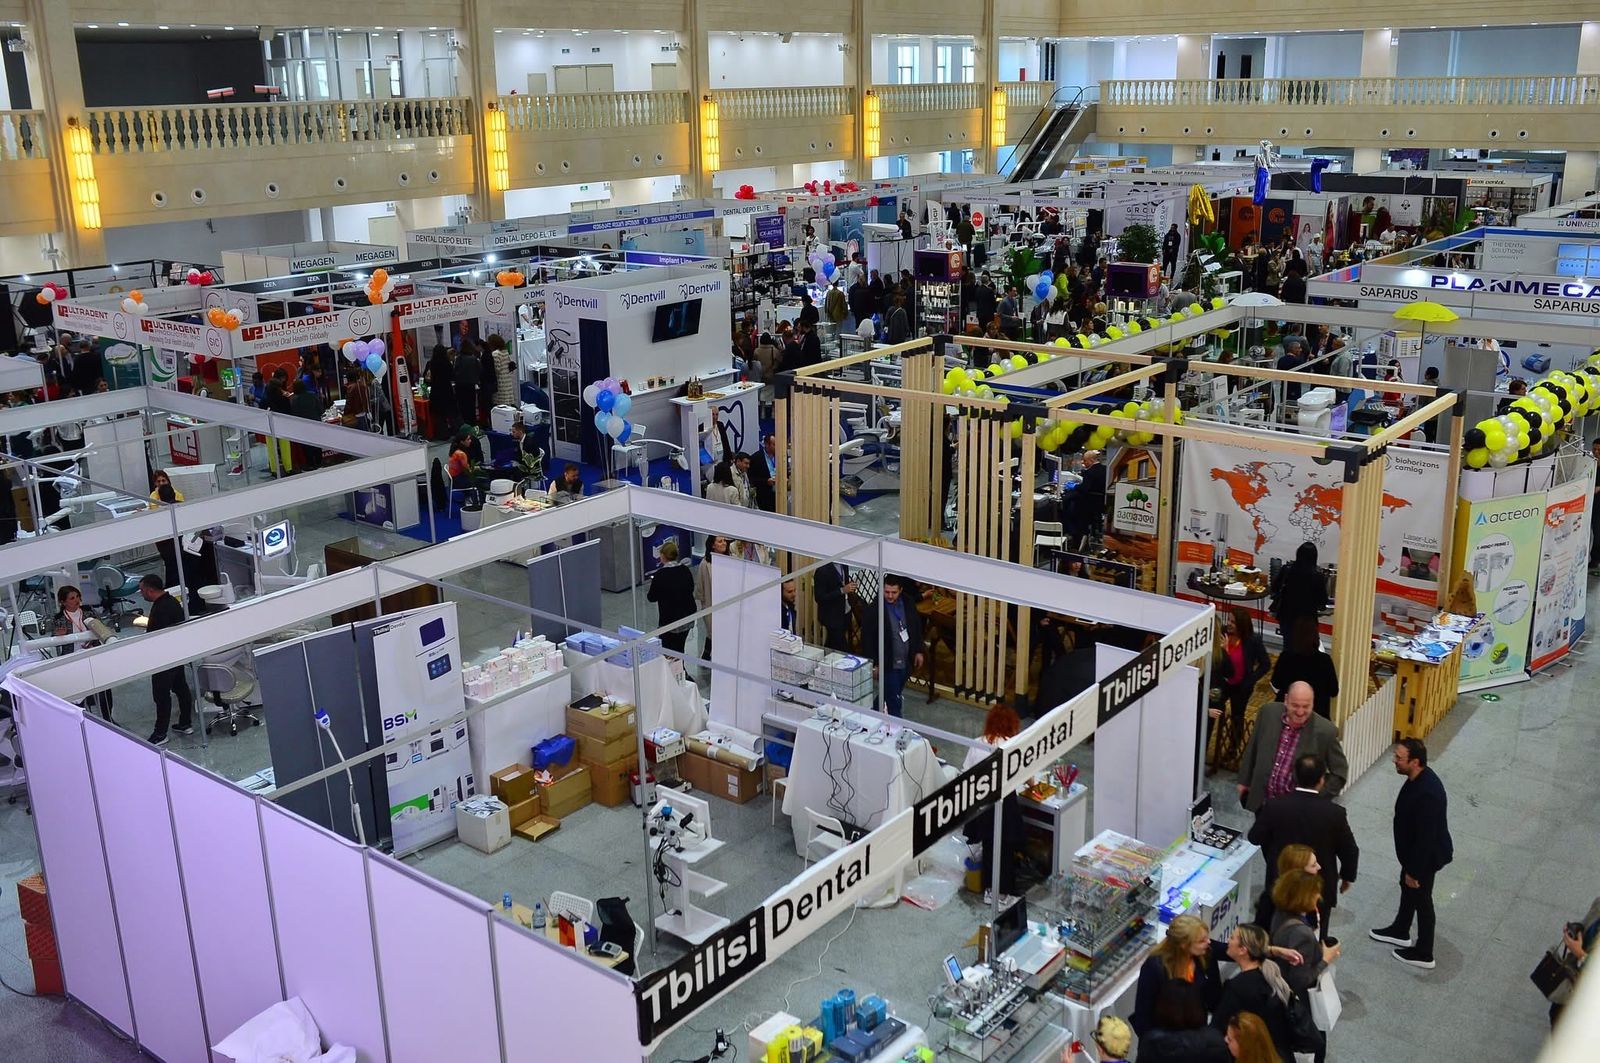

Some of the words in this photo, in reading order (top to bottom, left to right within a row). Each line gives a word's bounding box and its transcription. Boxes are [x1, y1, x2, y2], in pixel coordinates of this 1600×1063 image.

[723, 208, 742, 216] DENTAL
[416, 234, 437, 243] DENTAL
[438, 236, 455, 245] DEPO
[494, 235, 519, 245] DENTAL
[520, 232, 539, 241] DEPO
[293, 257, 335, 269] MEGAGEN
[356, 250, 395, 262] MEGAGEN
[688, 281, 721, 295] Dentvill
[1360, 286, 1418, 300] SAPARUS
[1431, 275, 1600, 298] PLANMECA
[413, 292, 478, 309] ULTRADENT
[488, 296, 501, 305] SIC
[564, 295, 598, 308] Dentvill
[631, 290, 666, 304] Dentvill
[68, 307, 108, 319] ULTRADENT
[1534, 299, 1600, 313] SAPARUS
[153, 321, 200, 335] ULTRADENT
[264, 314, 340, 332] ULTRADENT
[352, 317, 368, 328] SIC
[254, 339, 279, 350] Improving
[280, 337, 291, 346] Oral
[292, 334, 308, 344] Health
[309, 331, 329, 342] Globally
[1395, 456, 1439, 469] biohorizons
[1395, 465, 1423, 474] camlog
[1489, 507, 1539, 523] acteon
[1103, 654, 1158, 712] Tbilisi
[1163, 617, 1214, 671] Dental
[384, 708, 417, 730] BSM
[920, 761, 998, 837] Tbilisi
[1006, 710, 1074, 780] Dental
[642, 917, 758, 1023] Tbilisi
[772, 844, 870, 939] Dental
